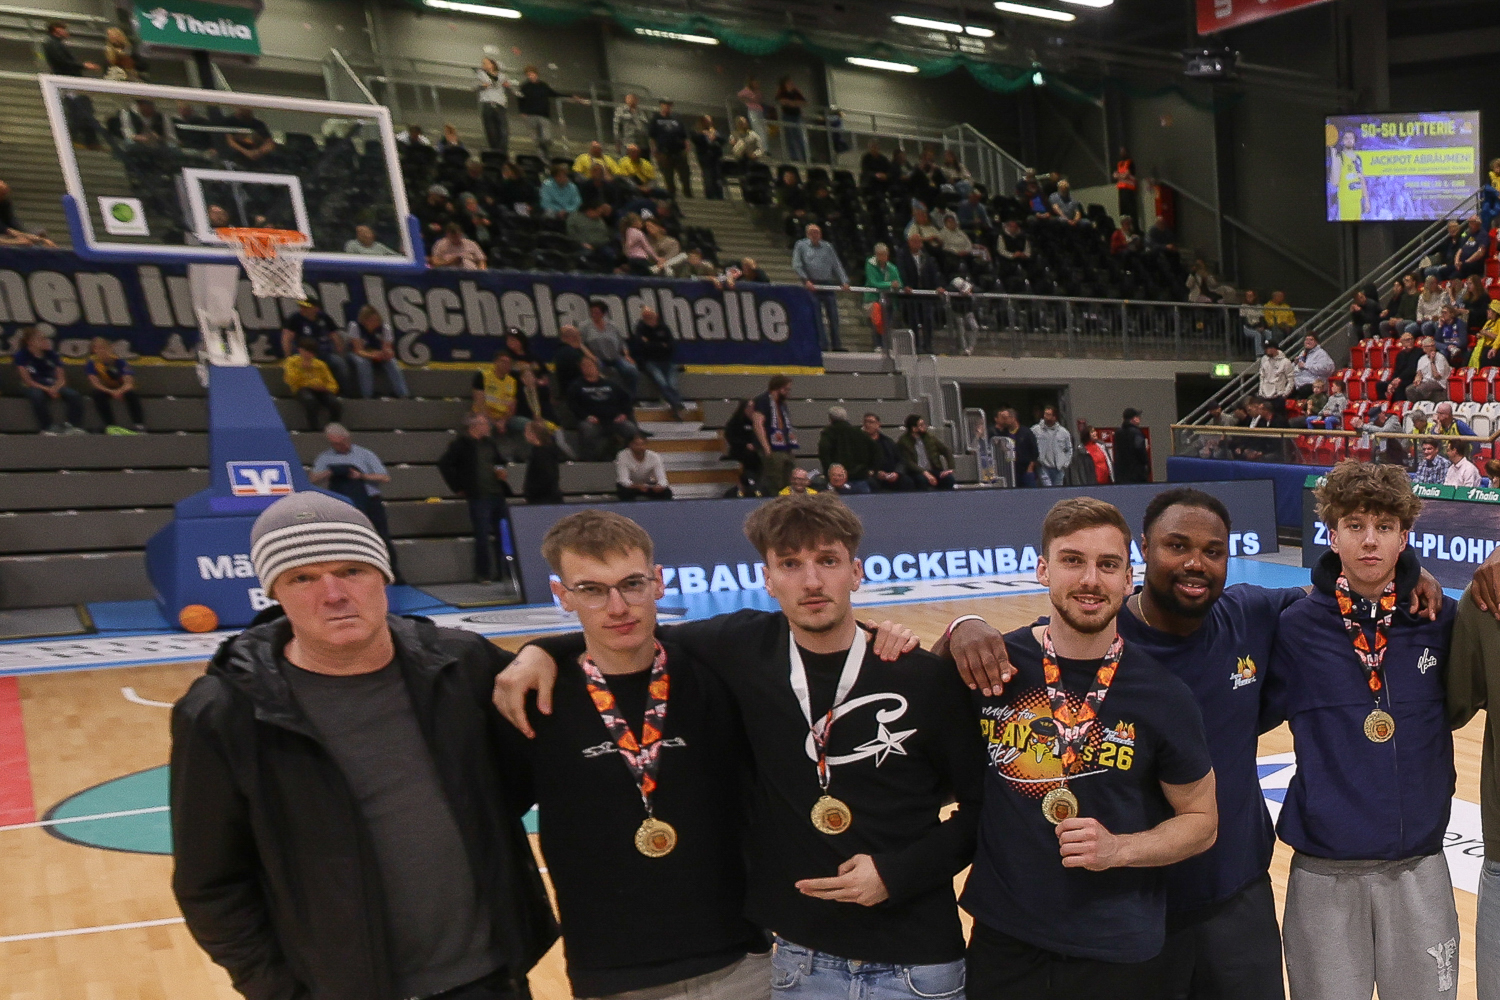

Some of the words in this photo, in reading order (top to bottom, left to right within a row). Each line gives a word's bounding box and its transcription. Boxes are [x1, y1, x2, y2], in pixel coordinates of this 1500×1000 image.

[170, 12, 252, 40] Thalia
[1399, 120, 1455, 137] LOTTERIE
[1419, 485, 1441, 498] Thalia
[1474, 488, 1500, 501] Thalia
[1018, 708, 1037, 721] for
